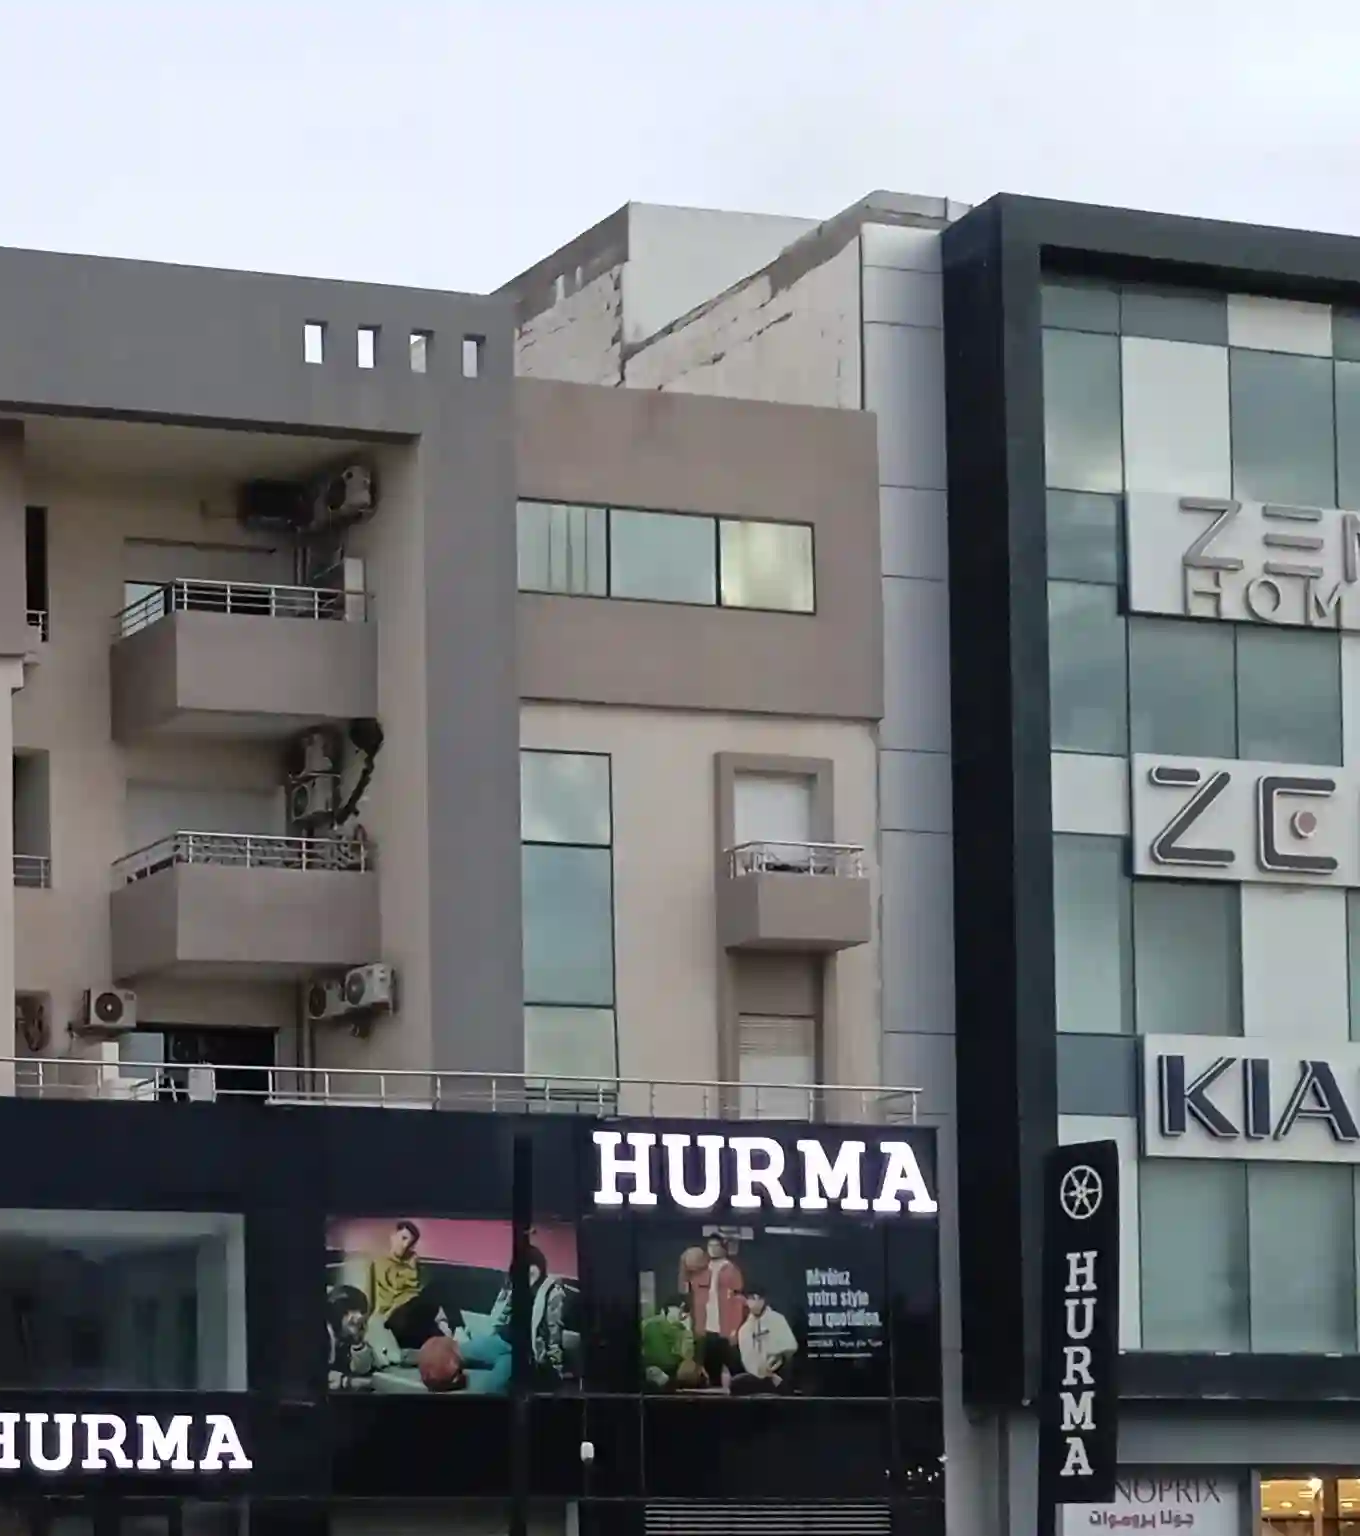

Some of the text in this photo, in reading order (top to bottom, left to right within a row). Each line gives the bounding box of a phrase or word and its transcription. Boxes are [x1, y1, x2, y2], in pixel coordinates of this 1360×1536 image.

[1183, 566, 1342, 628] HOM
[1158, 1053, 1360, 1142] KIA
[592, 1130, 938, 1213] HURMA
[1059, 1250, 1098, 1477] HURMA
